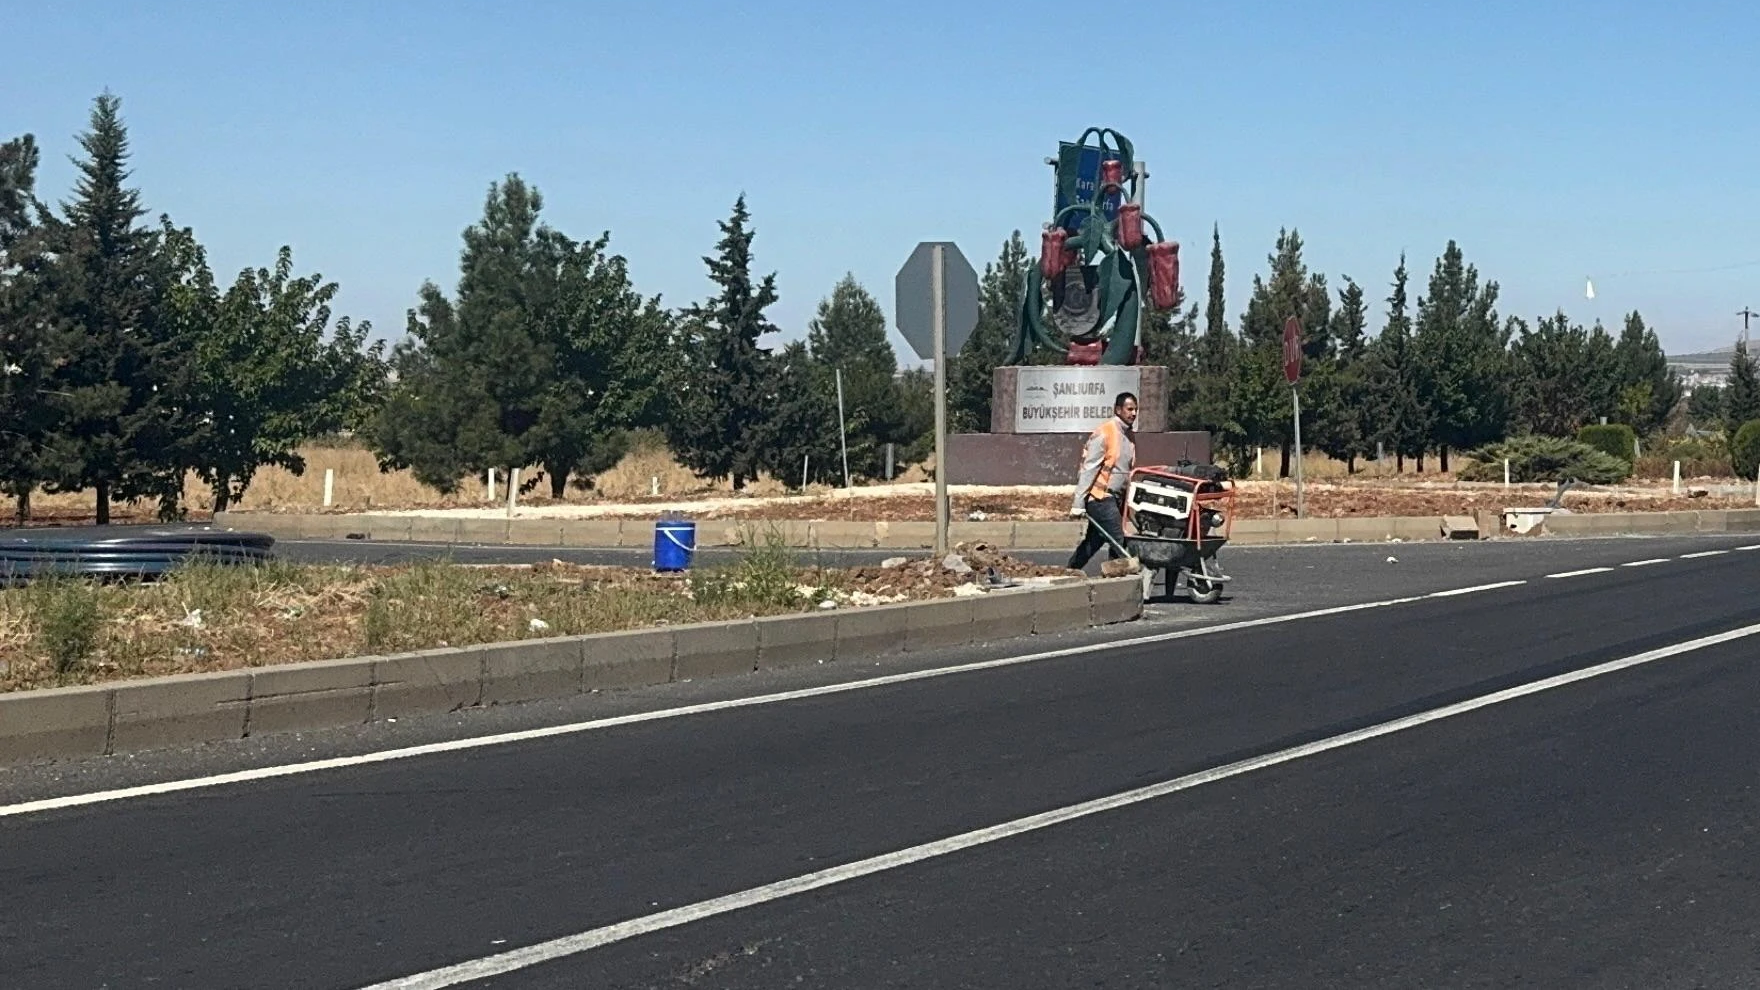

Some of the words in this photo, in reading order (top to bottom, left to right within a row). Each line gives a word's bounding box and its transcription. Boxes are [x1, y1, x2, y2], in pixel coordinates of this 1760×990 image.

[1052, 381, 1106, 398] ŞANLIURFA
[1022, 403, 1080, 423] BÜYÜKŞEHİR
[1083, 406, 1114, 420] BELED
